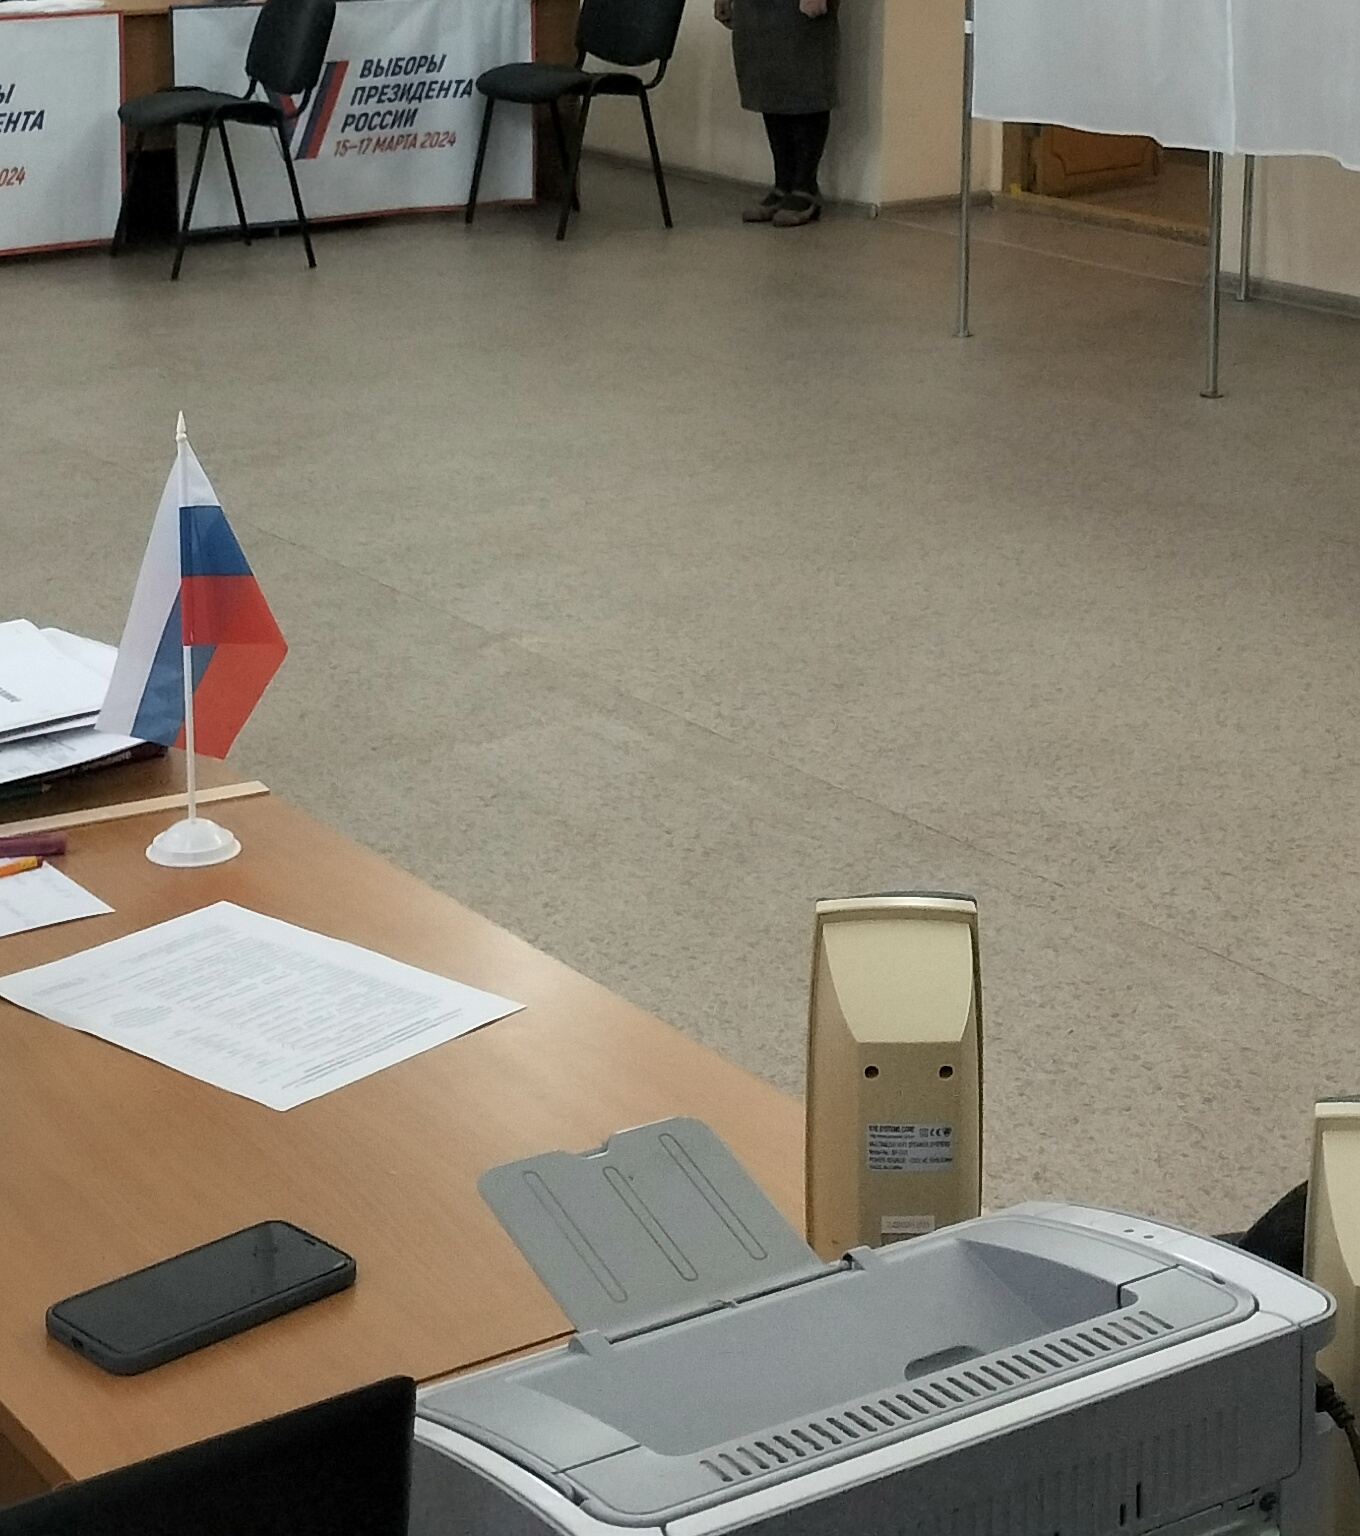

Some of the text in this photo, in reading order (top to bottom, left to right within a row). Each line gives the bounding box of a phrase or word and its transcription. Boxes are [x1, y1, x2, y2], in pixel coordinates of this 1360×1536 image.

[359, 54, 447, 79] ВЫБОРЫ
[350, 79, 473, 106] ПРЕЗИДЕНТА
[341, 108, 418, 133] РОССИИ
[373, 133, 418, 153] МАРТА
[421, 131, 456, 148] 2024
